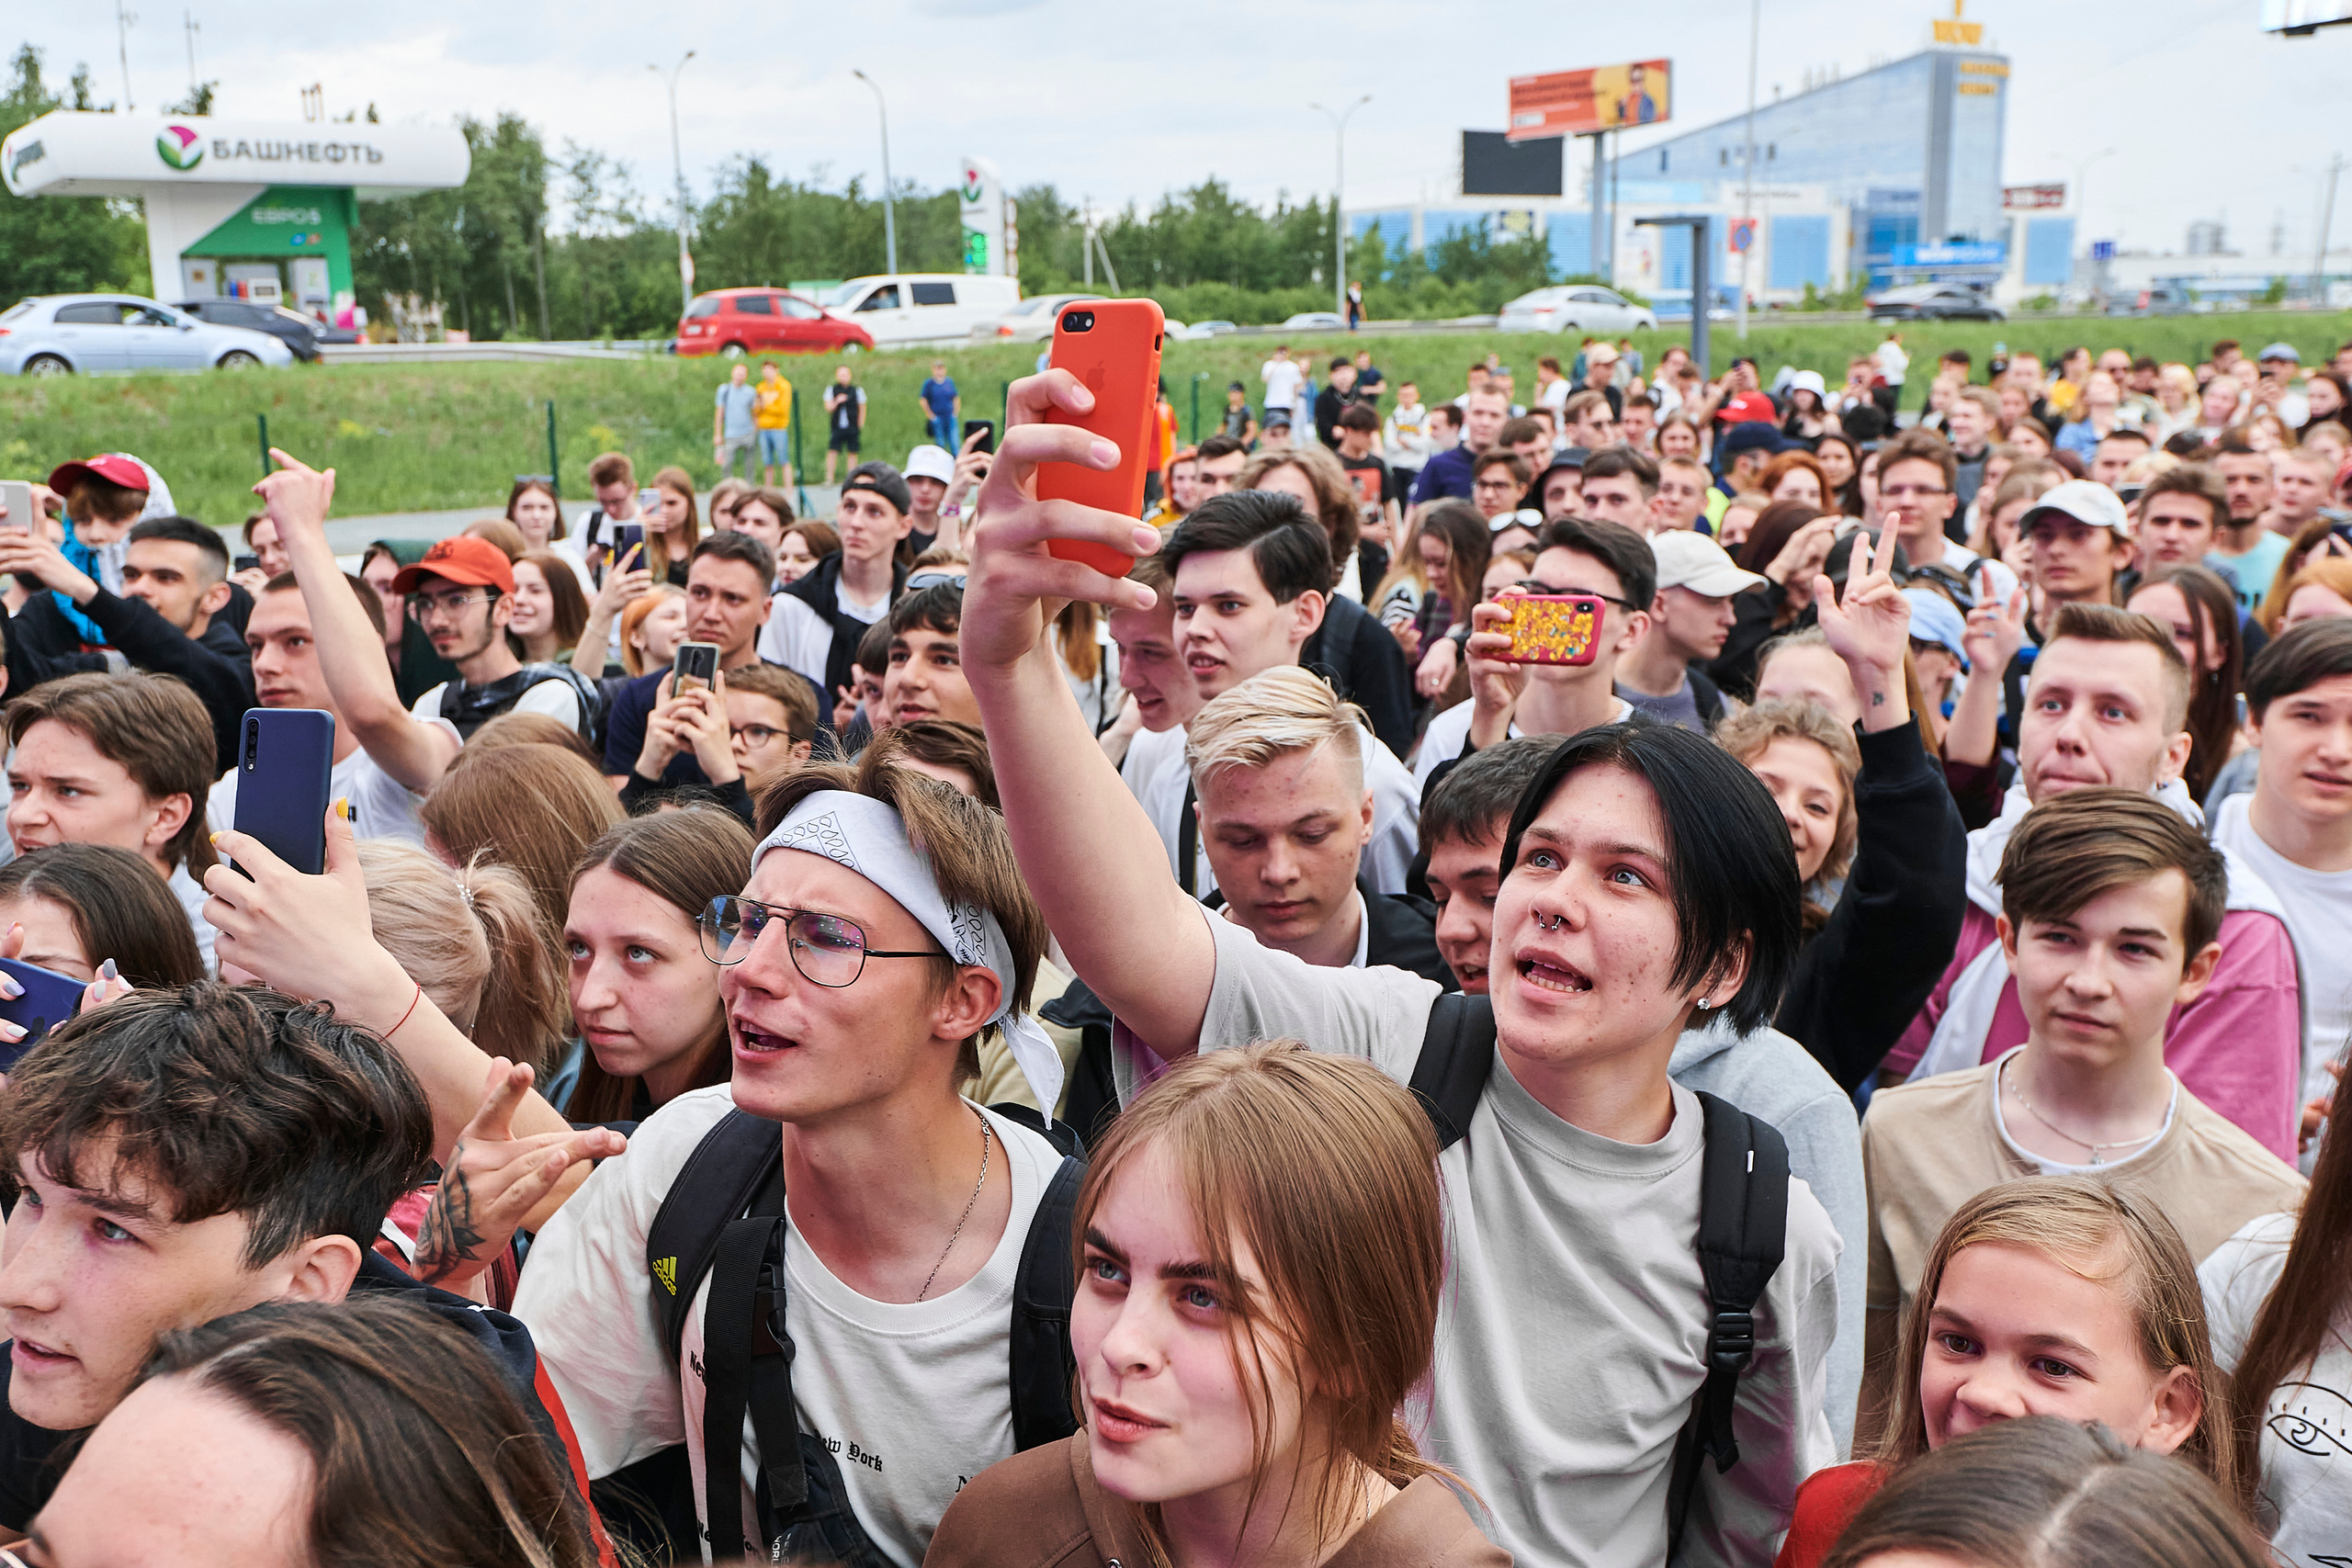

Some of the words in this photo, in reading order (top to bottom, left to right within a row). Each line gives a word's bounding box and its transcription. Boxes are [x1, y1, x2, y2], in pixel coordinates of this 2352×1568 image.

[212, 139, 383, 164] БАШНЕФТЬ
[652, 1261, 677, 1296] adidas
[847, 1441, 883, 1472] York
